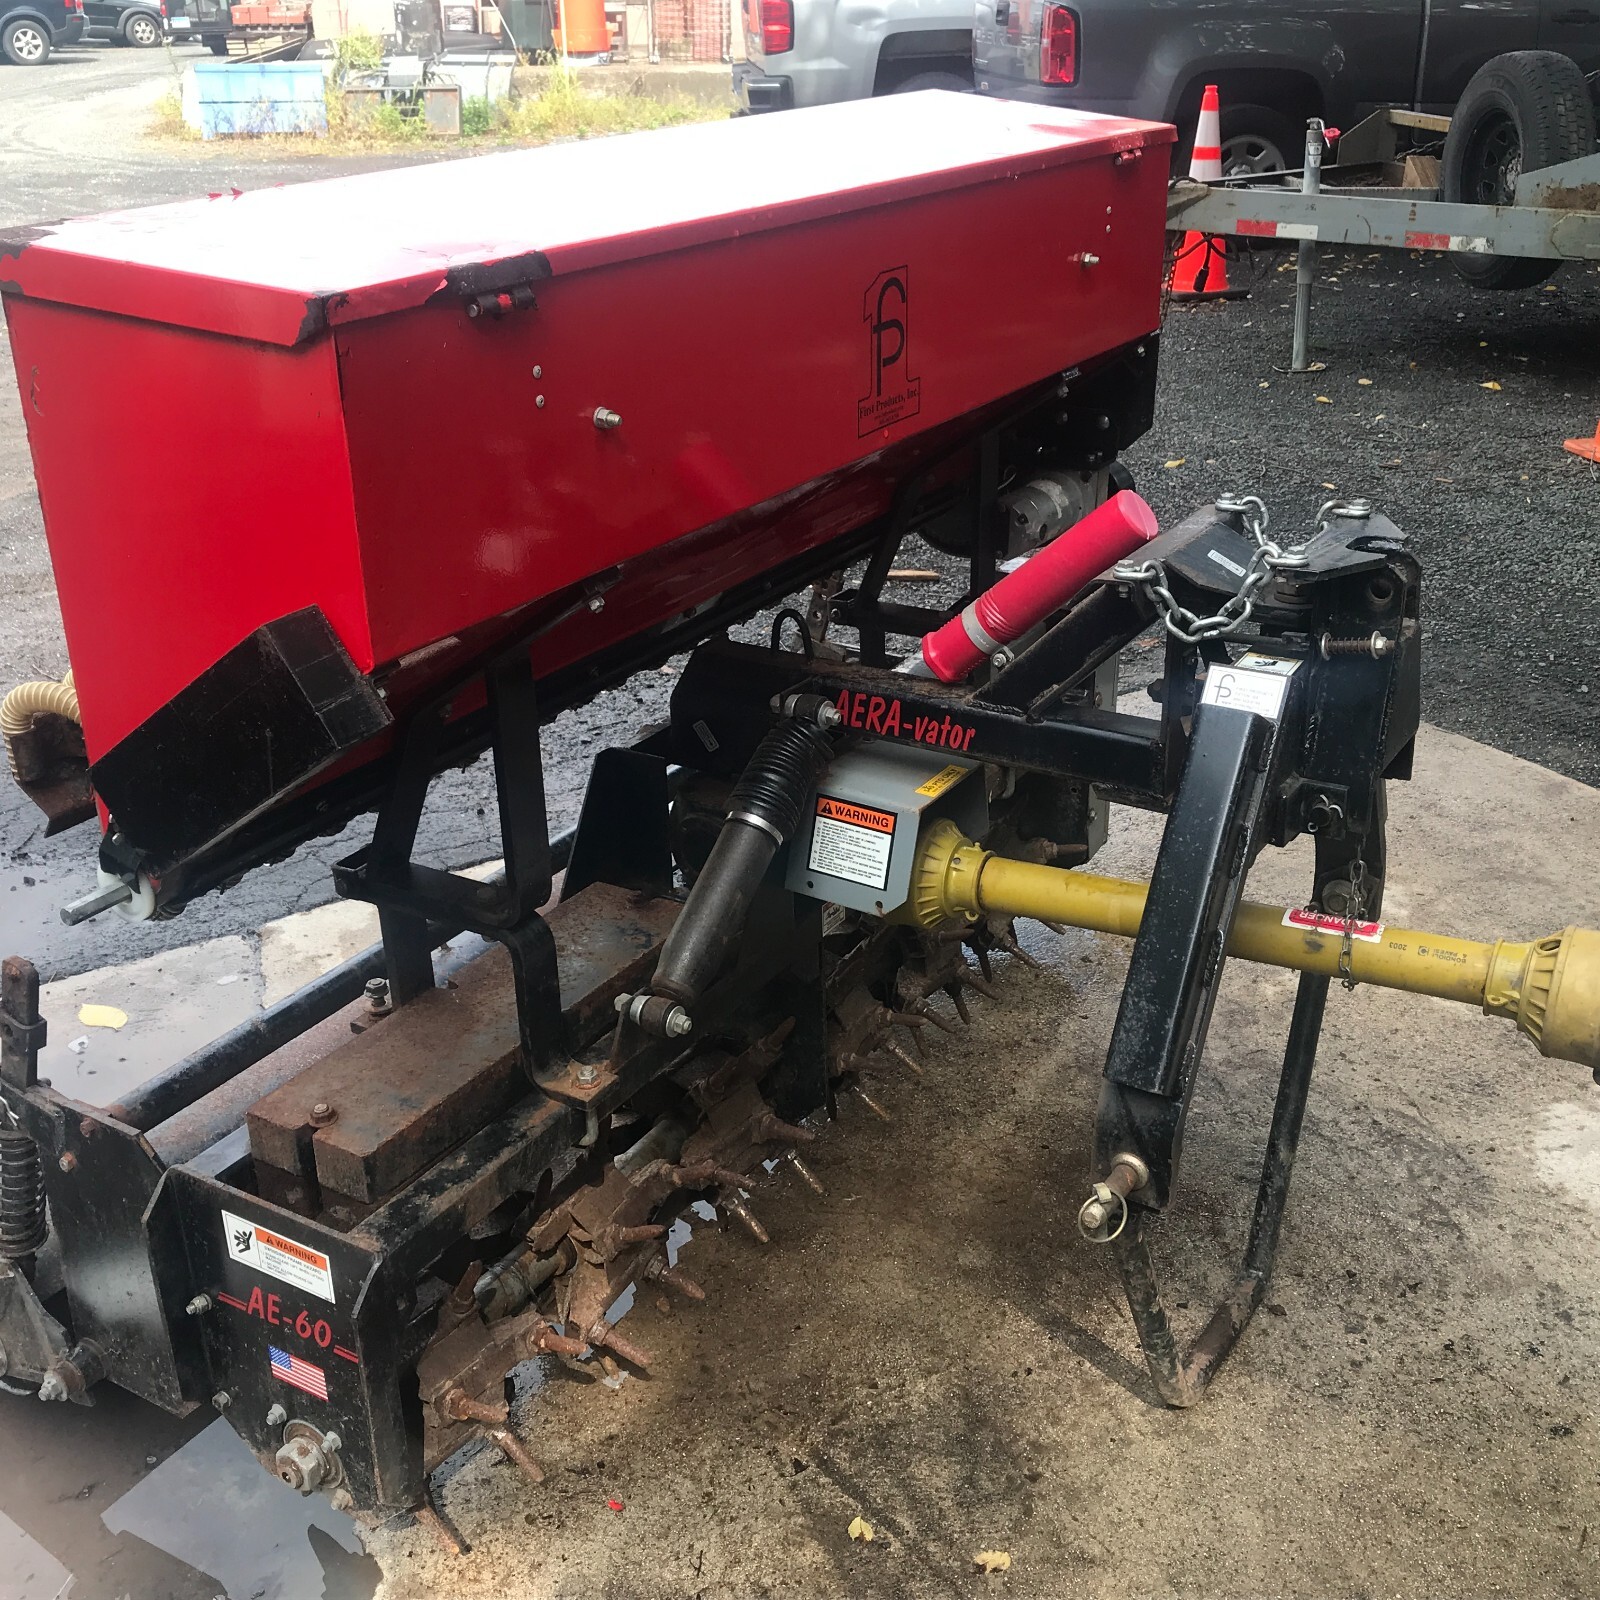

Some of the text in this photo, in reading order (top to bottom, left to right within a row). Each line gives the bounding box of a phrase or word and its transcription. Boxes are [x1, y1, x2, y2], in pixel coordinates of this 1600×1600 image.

[860, 404, 875, 419] First
[835, 689, 976, 751] AERA-vator
[835, 805, 889, 828] WARNING
[1389, 941, 1408, 951] 2003
[1431, 953, 1467, 964] BONDIOLI
[275, 1240, 317, 1264] WARNING
[248, 1286, 332, 1347] AE-60
